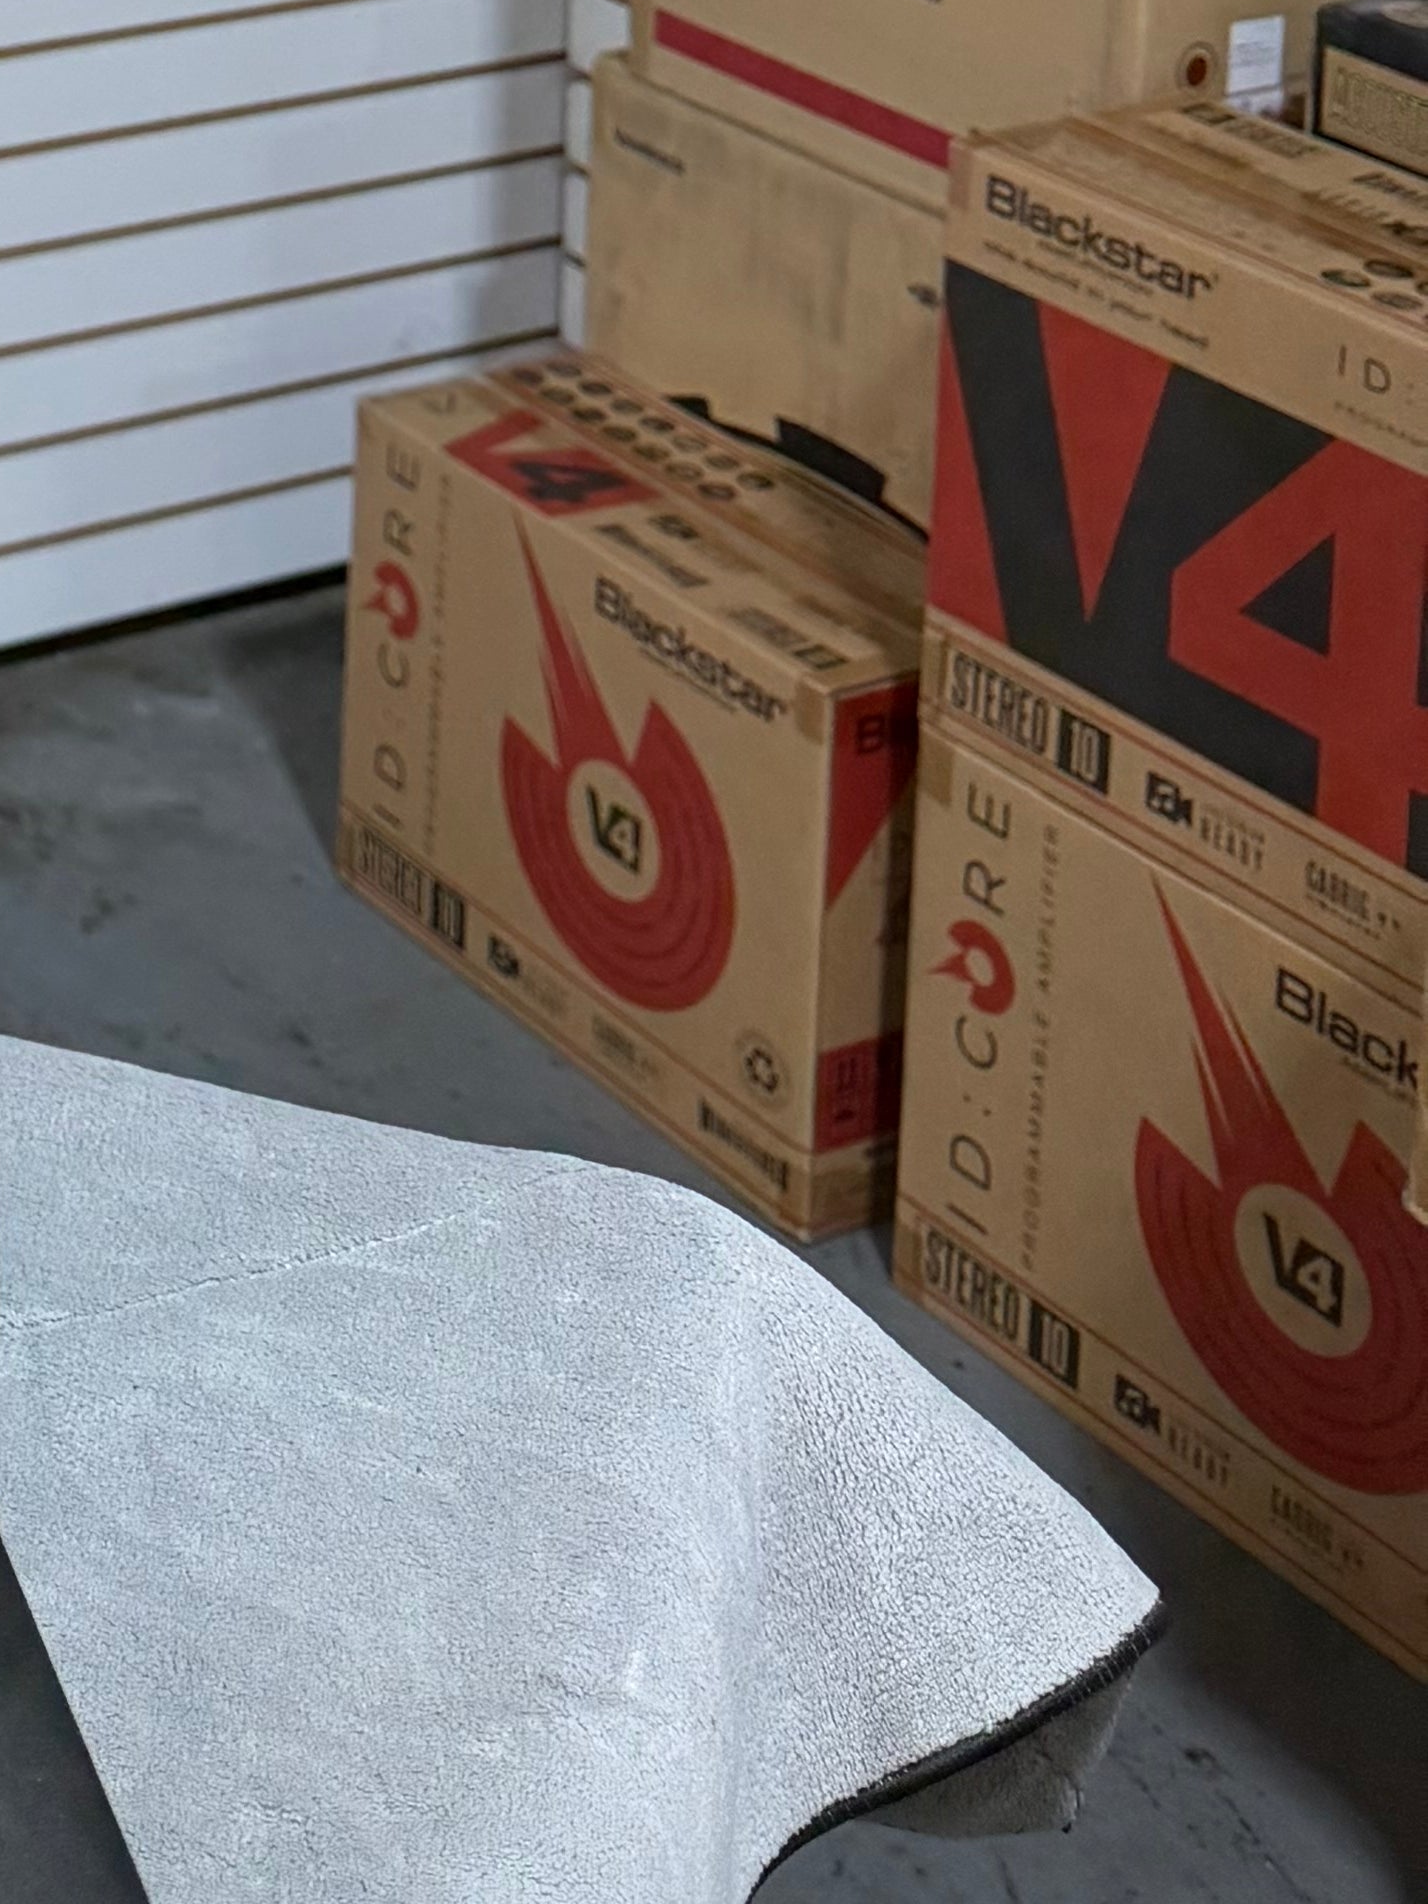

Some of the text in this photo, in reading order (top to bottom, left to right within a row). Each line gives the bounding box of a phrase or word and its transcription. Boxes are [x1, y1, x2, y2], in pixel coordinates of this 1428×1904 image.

[984, 174, 1214, 301] Blackstar
[594, 575, 789, 724] Blackstar
[950, 652, 1046, 757] STEREO
[922, 1226, 1021, 1342] STEREO
